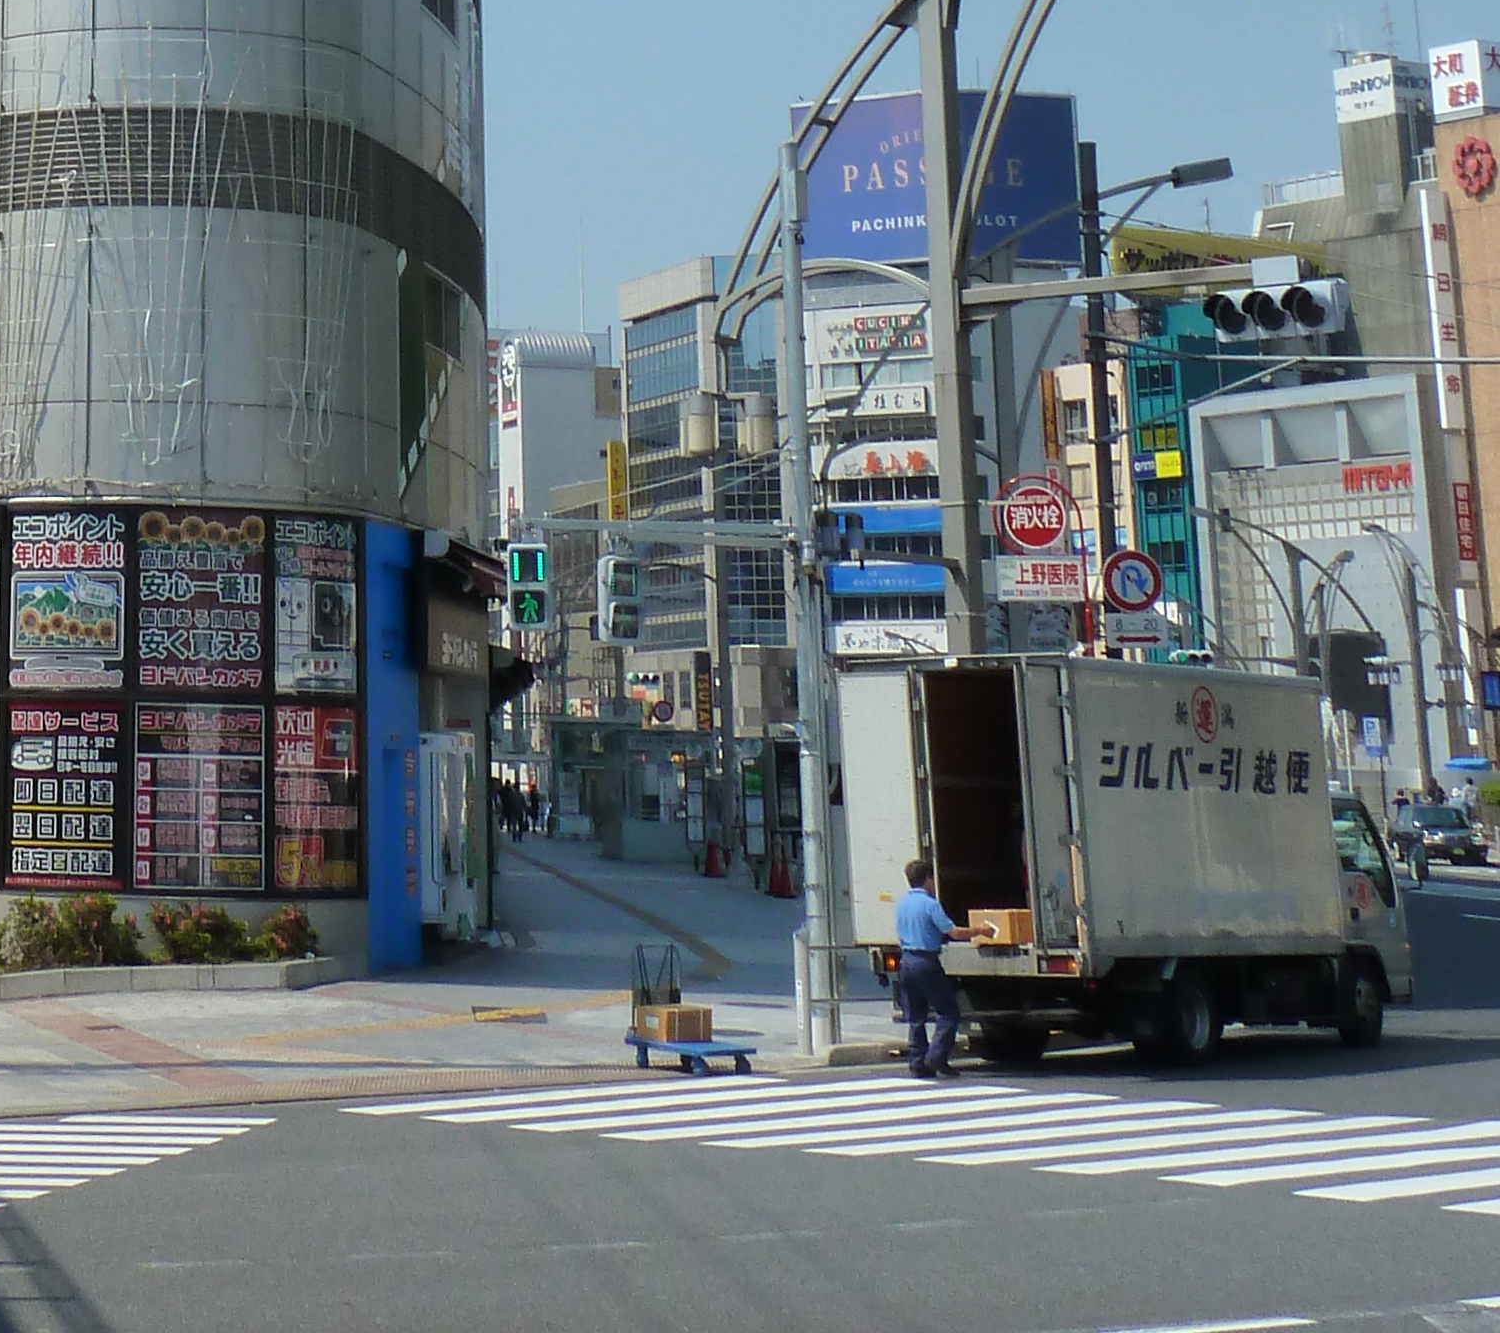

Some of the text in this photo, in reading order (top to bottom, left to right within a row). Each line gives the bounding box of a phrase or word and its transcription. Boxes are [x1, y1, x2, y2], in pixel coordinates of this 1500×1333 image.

[1432, 52, 1464, 78] 大和
[1447, 81, 1480, 107] 証券
[852, 215, 927, 233] PACHINK
[1432, 222, 1462, 395] 朝日生命
[856, 333, 925, 351] ITAIA
[12, 511, 125, 541] エコポイント
[1011, 505, 1061, 530] 消火栓
[13, 541, 124, 569] 年内継続!!
[139, 570, 261, 604] 安心一番!!
[1015, 563, 1080, 586] 上野医院
[139, 629, 261, 661] 安く買える
[139, 666, 262, 688] ヨドバシカメラ
[11, 710, 119, 732] 配達サービス
[139, 711, 261, 732] ヨドバシカメラ
[1100, 739, 1312, 795] シルバー引越便
[13, 777, 114, 806] 即日配達
[12, 812, 114, 841] 翌日配達
